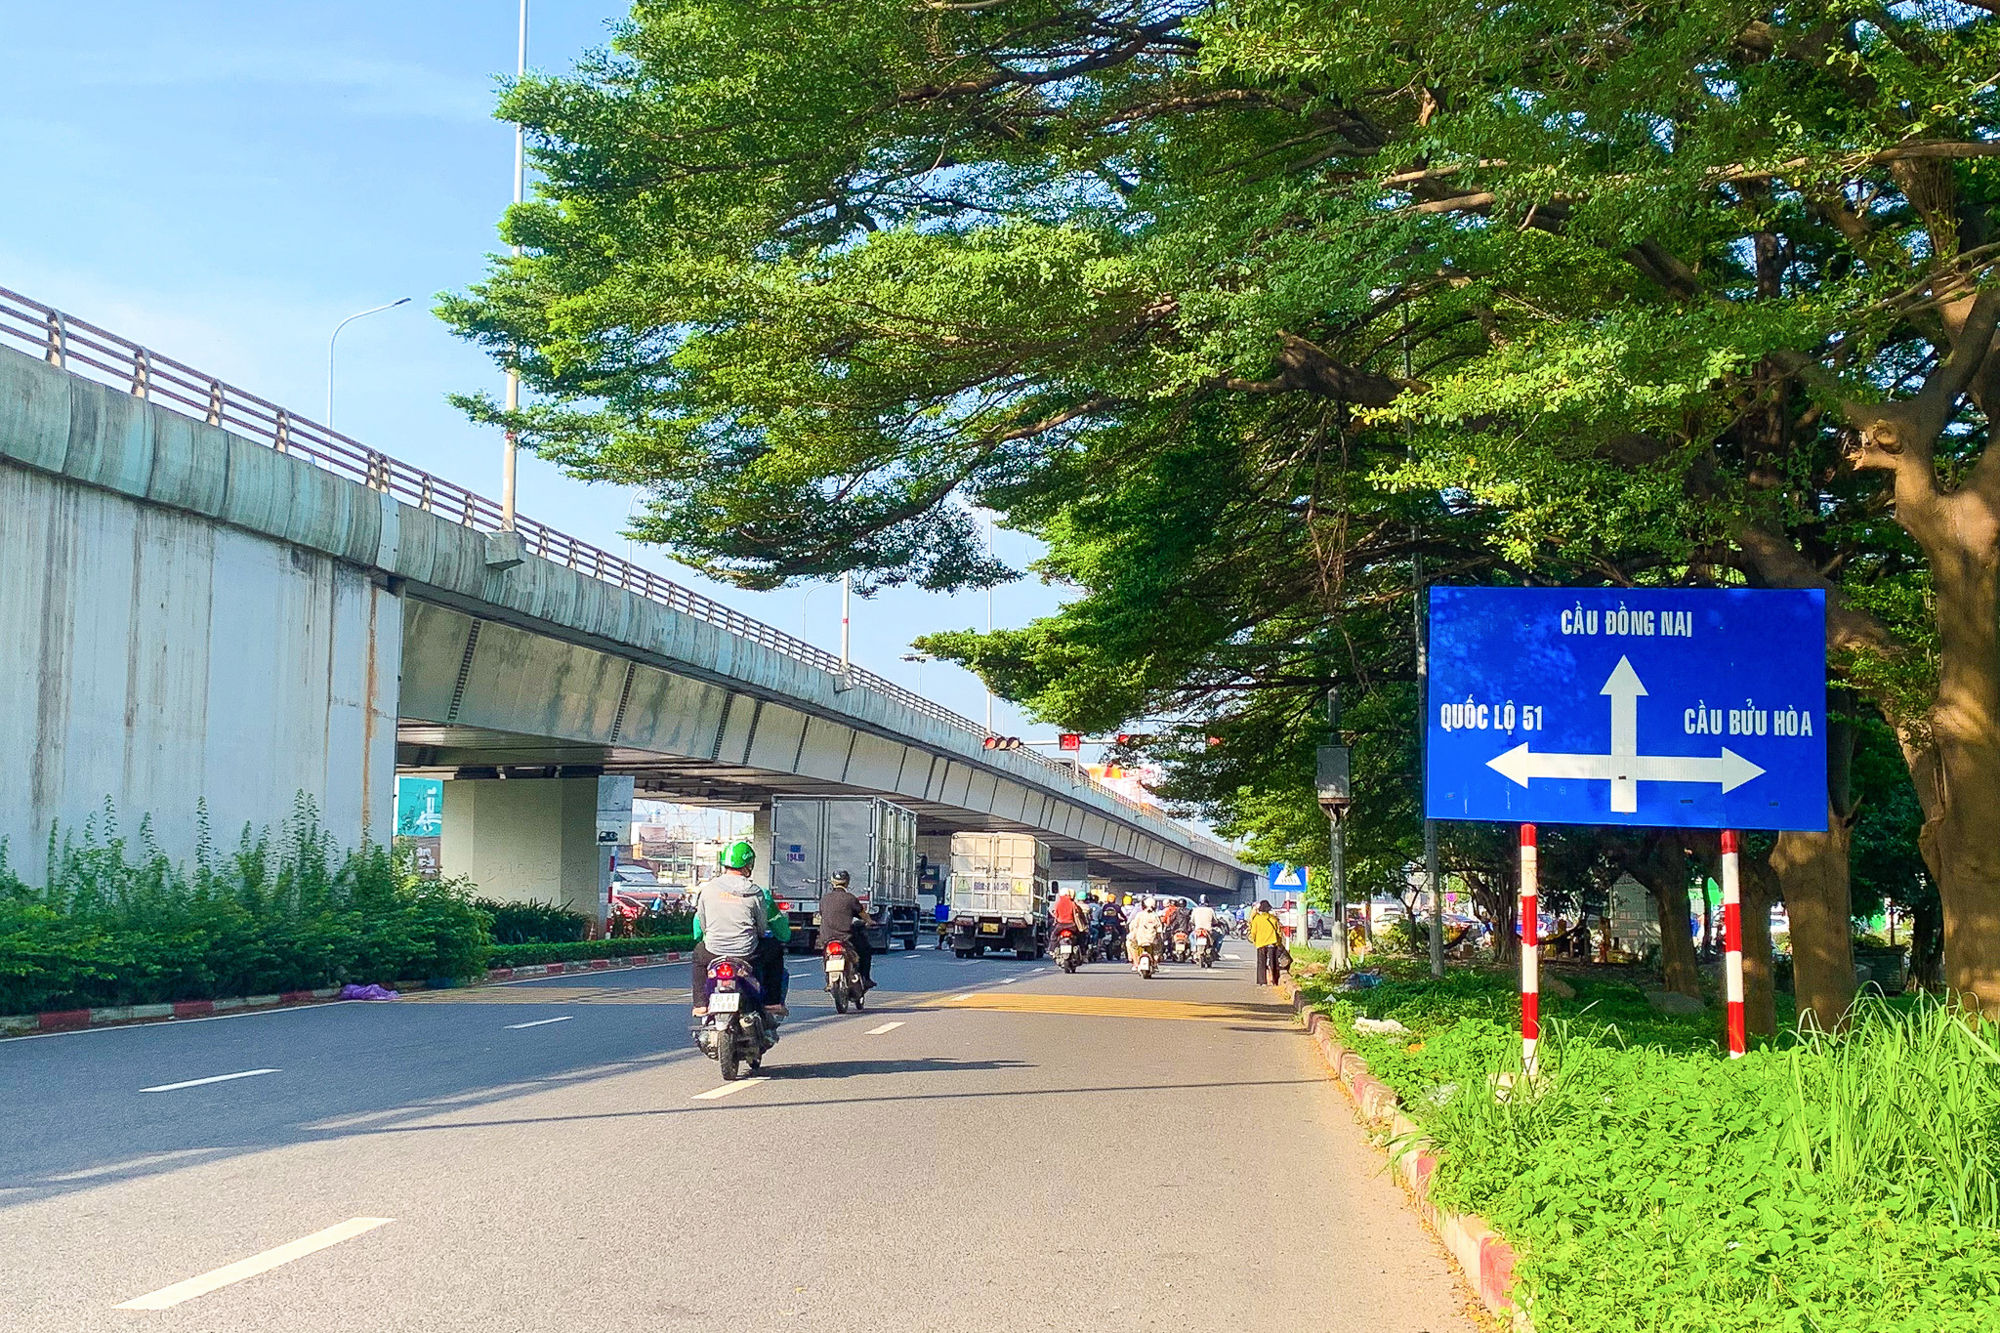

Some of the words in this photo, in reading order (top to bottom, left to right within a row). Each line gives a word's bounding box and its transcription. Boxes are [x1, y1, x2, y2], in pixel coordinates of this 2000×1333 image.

[1561, 601, 1598, 635] CẦU
[1605, 601, 1655, 636] ĐỒNG
[1660, 610, 1693, 638] NAI
[1440, 694, 1489, 732] QUỐC
[1493, 699, 1516, 735] LỘ
[1522, 705, 1543, 731] 51
[1684, 700, 1723, 735] CẦU
[1728, 698, 1767, 736] BỬU
[1774, 705, 1813, 737] HÒA
